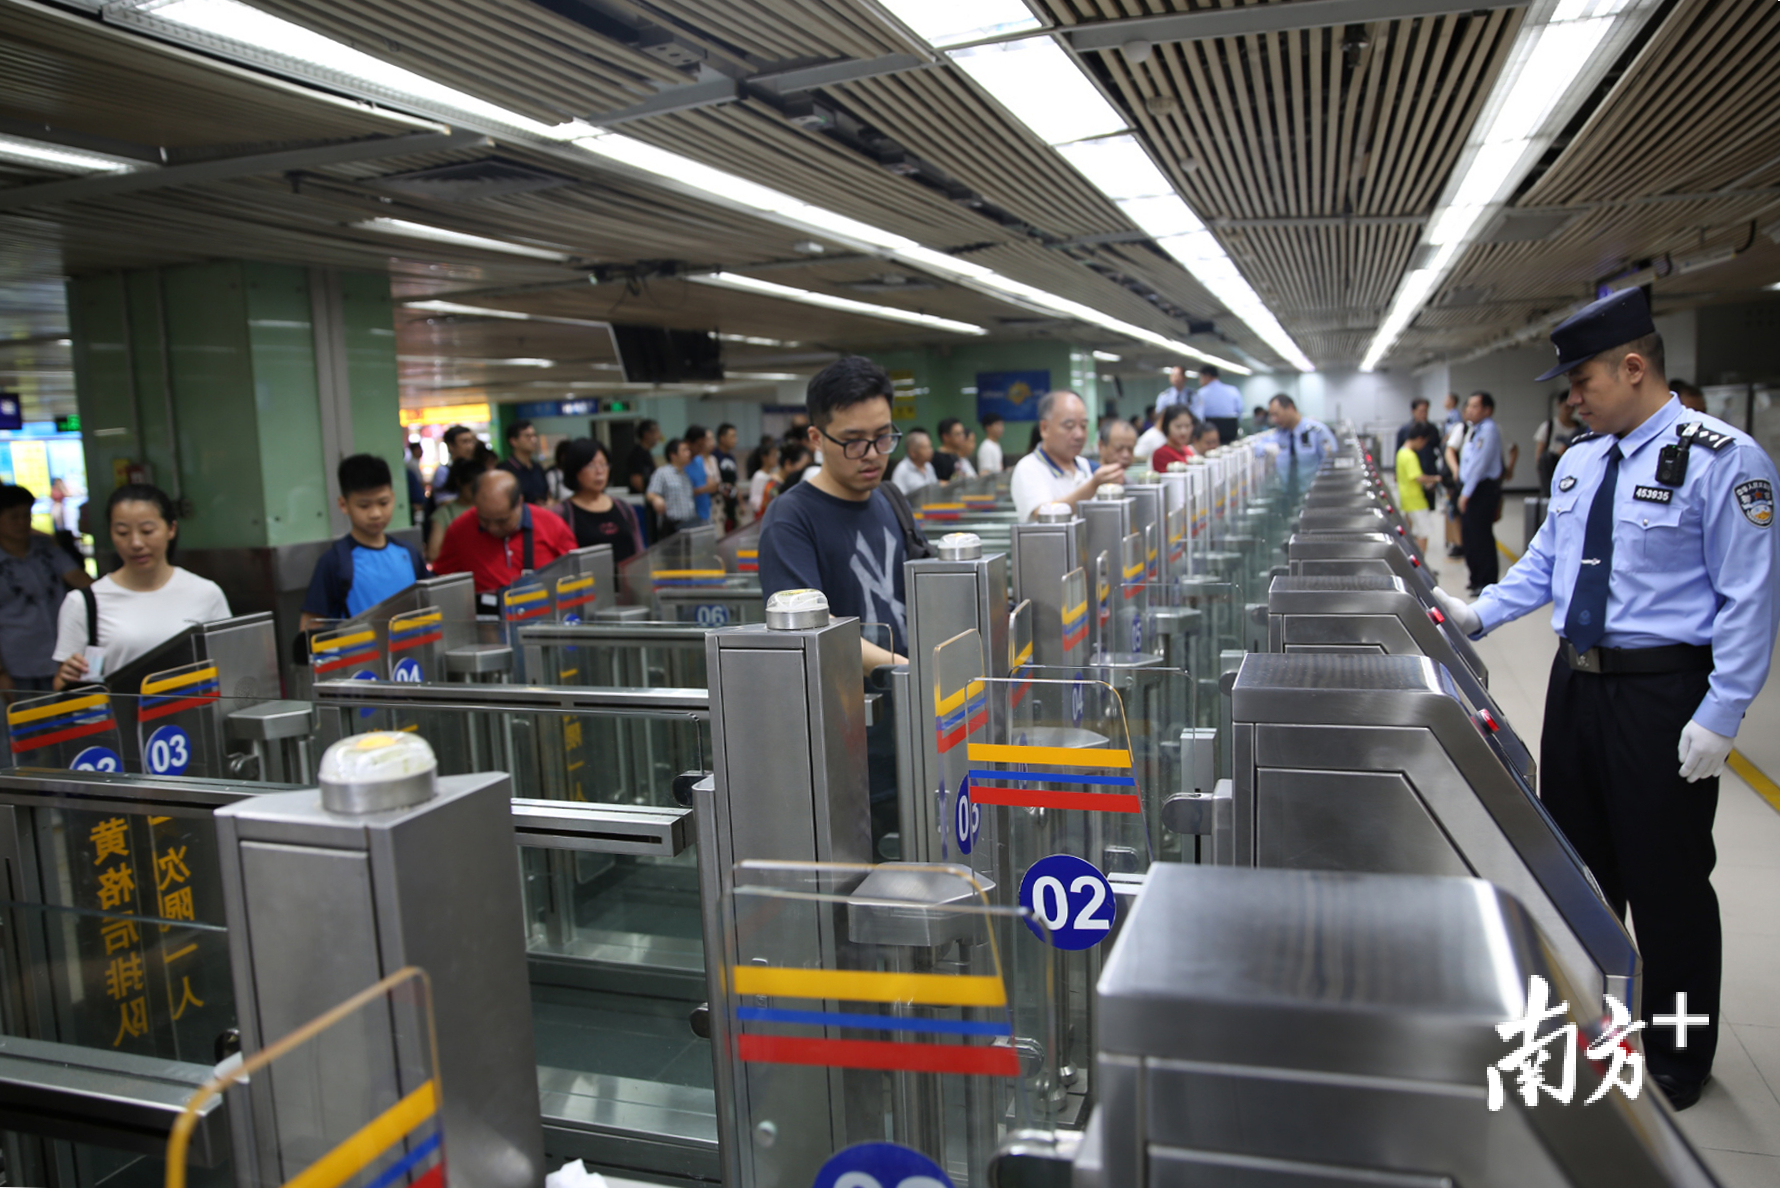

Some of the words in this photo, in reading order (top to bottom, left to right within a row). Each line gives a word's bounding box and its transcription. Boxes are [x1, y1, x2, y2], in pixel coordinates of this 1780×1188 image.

[1635, 487, 1670, 501] 453935
[697, 605, 725, 627] 06
[151, 734, 188, 773] 03
[1032, 875, 1110, 931] 02
